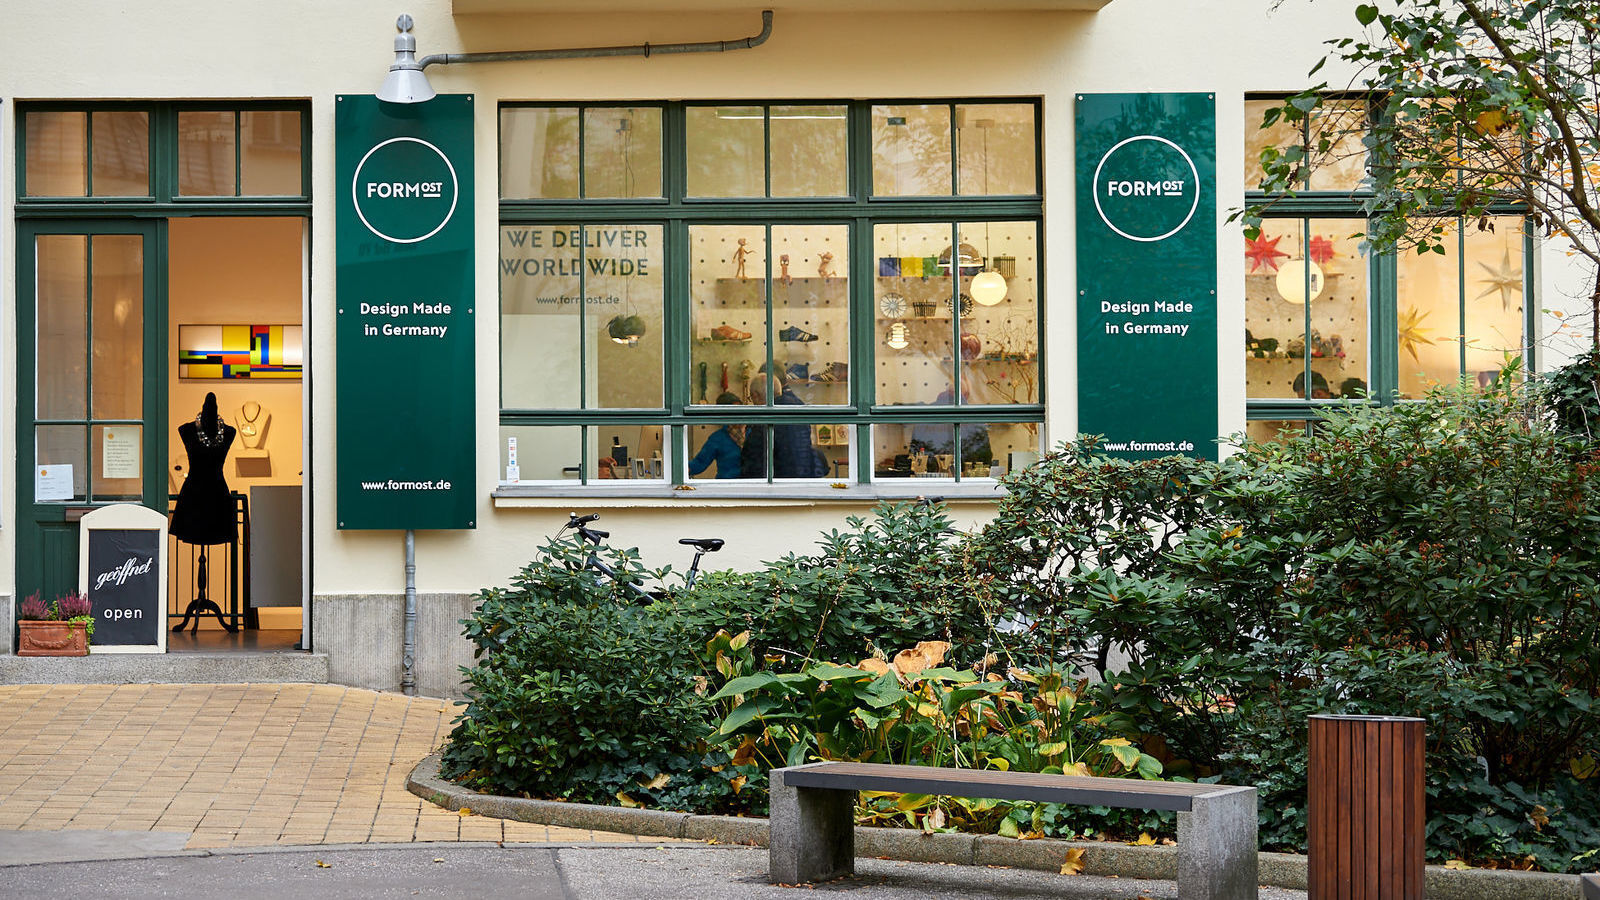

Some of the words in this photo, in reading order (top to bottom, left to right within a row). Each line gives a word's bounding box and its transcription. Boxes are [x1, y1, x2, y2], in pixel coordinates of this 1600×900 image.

[367, 182, 443, 198] FORMOST
[1108, 180, 1185, 197] FORMOST
[506, 230, 543, 248] WE
[552, 230, 648, 248] DELIVER
[360, 303, 409, 317] Design
[413, 303, 452, 315] Made
[1101, 301, 1150, 315] Design
[1154, 301, 1193, 313] Made
[364, 324, 378, 336] in
[382, 324, 448, 338] Germany
[1105, 322, 1119, 334] in
[1123, 322, 1190, 336] Germany
[1103, 440, 1194, 452] www.formost.de
[361, 479, 452, 491] www.formost.de
[95, 557, 153, 590] geöffnet
[104, 609, 142, 622] open
